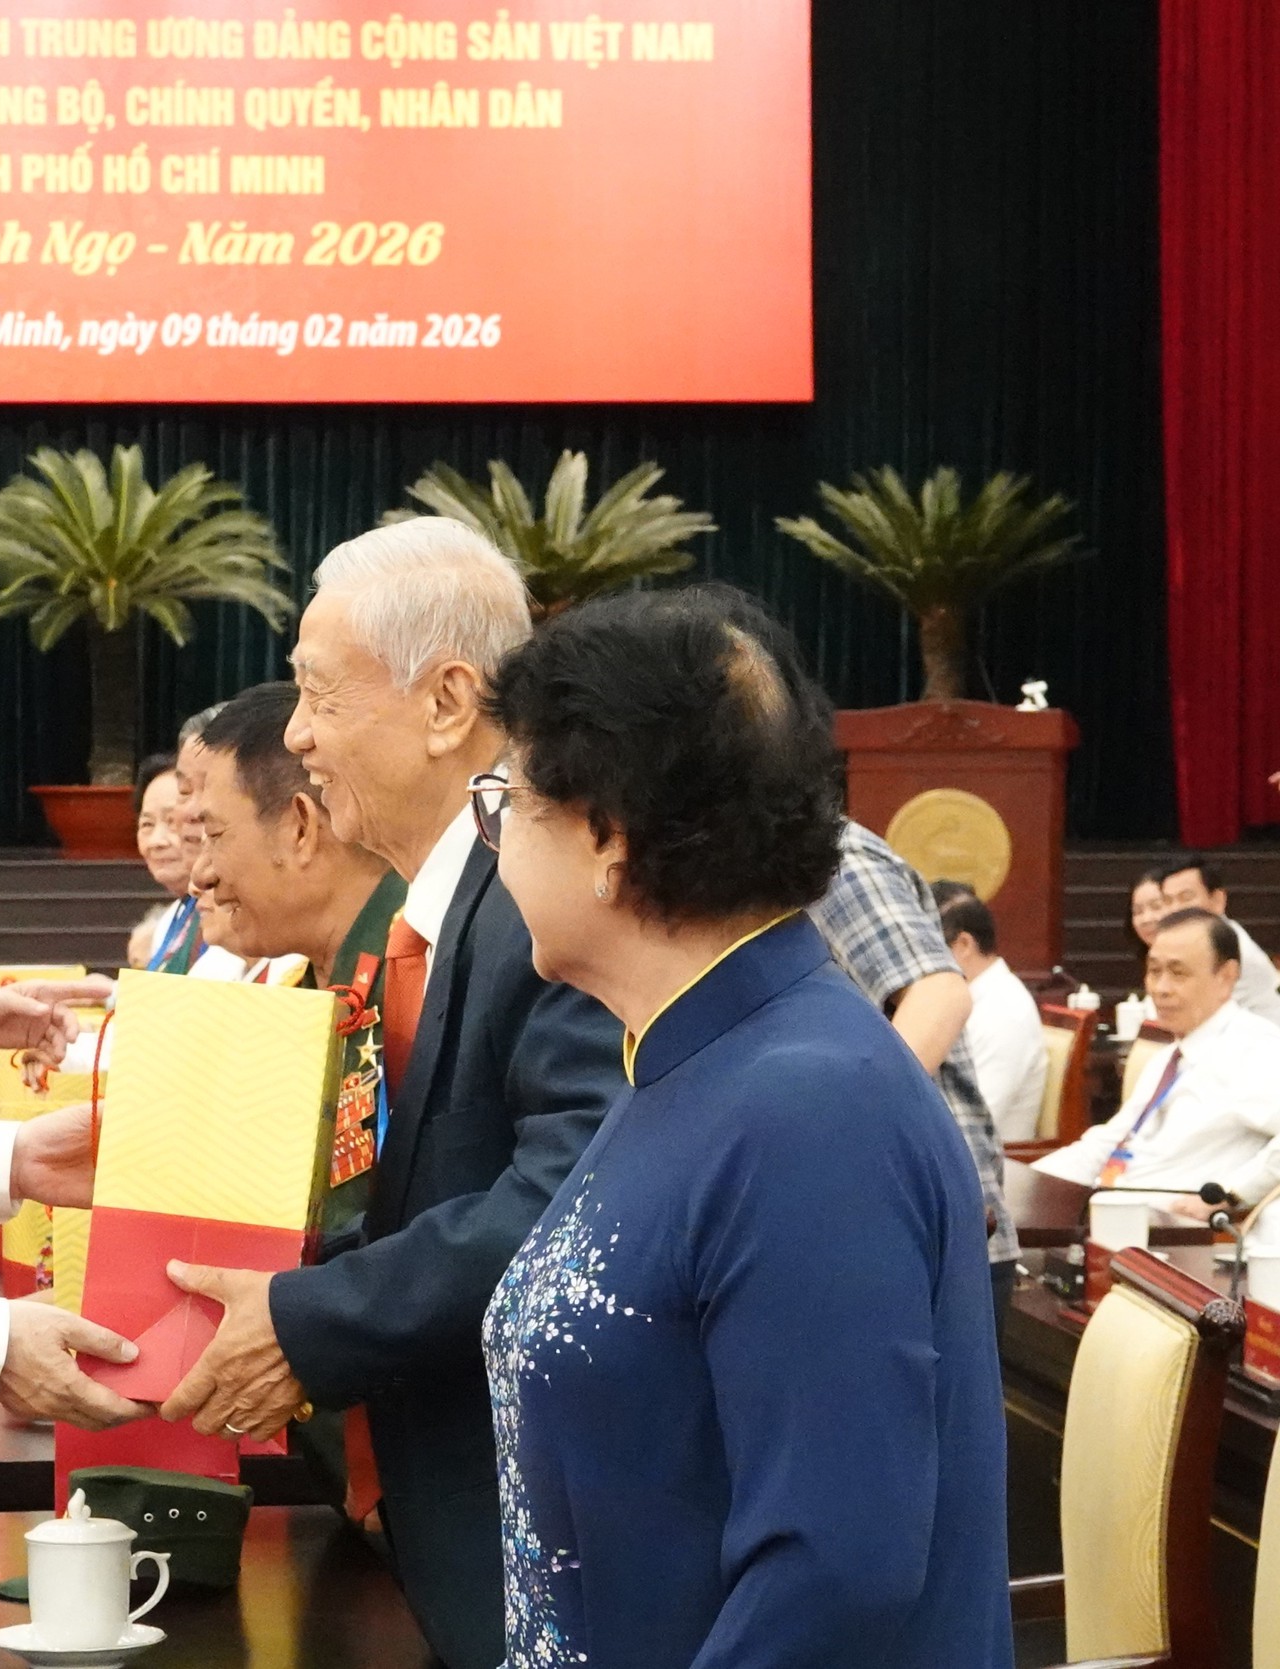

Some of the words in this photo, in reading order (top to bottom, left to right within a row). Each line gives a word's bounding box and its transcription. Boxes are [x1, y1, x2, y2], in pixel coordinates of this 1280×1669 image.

[21, 19, 136, 57] TRUNG
[148, 17, 243, 58] ƯƠNG
[254, 9, 350, 58] ĐẢNG
[362, 14, 457, 68] CỘNG
[468, 10, 539, 60] SẢN
[550, 15, 623, 69] VIỆT
[633, 23, 713, 60] NAM
[58, 80, 115, 133] BỘ,
[126, 81, 233, 125] CHÍNH
[245, 77, 370, 131] QUYỀN,
[381, 82, 479, 127] NHÂN
[489, 82, 561, 127] DÂN
[22, 142, 95, 192] PHỐ
[104, 143, 150, 193] HỒ
[161, 148, 219, 193] CHÍ
[231, 156, 324, 194] MINH
[41, 221, 136, 275] Ngọ
[179, 222, 294, 264] Năm
[304, 222, 444, 265] 2026
[78, 311, 157, 355] ngày
[162, 312, 202, 347] 09
[207, 311, 298, 356] tháng
[304, 313, 343, 347] 02
[348, 313, 417, 347] năm
[422, 313, 500, 347] 2026
